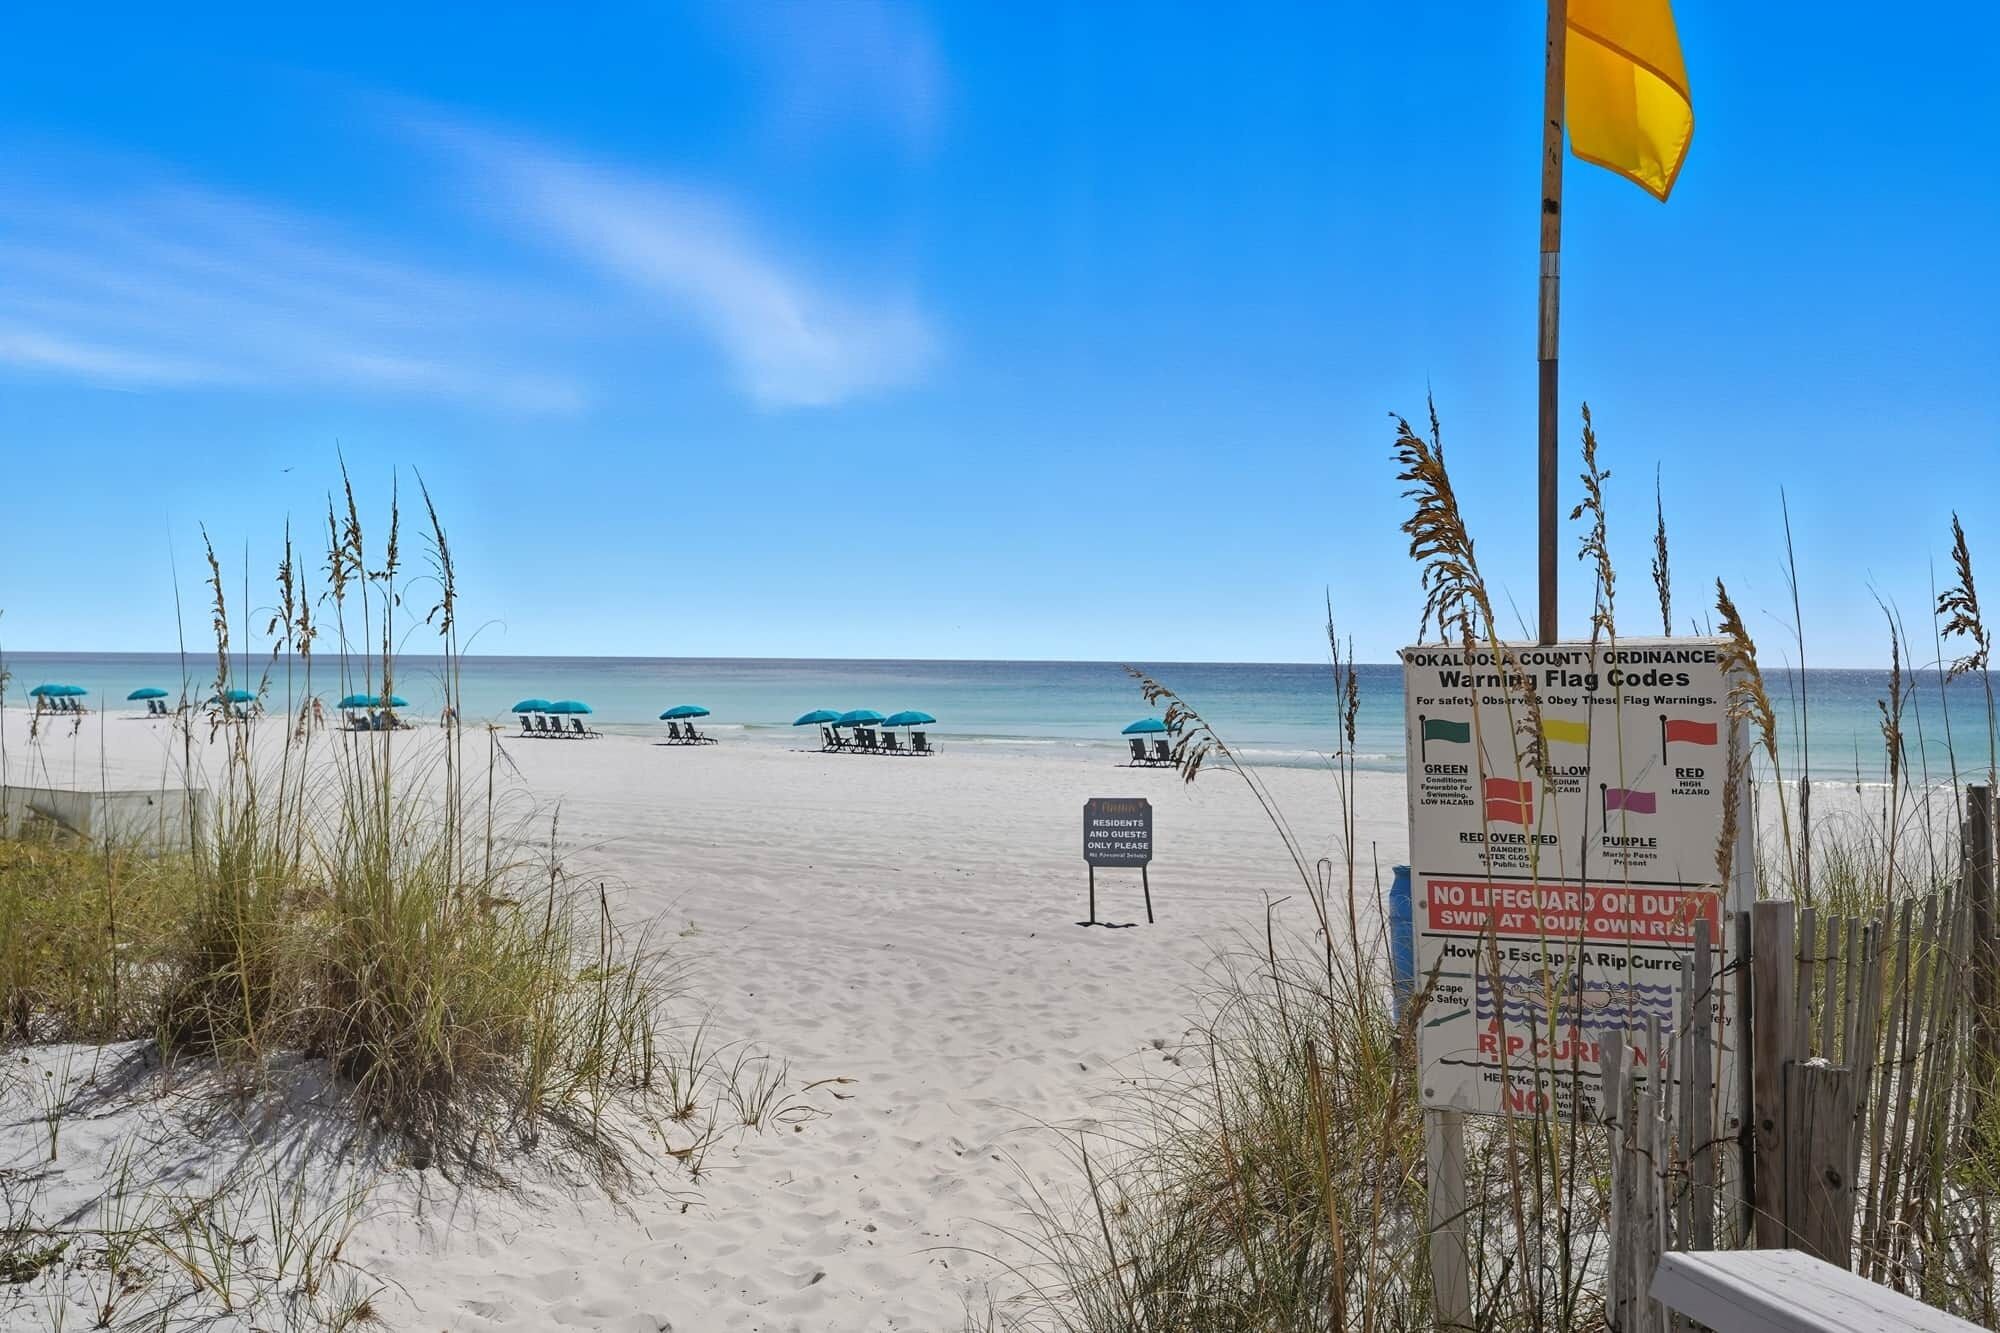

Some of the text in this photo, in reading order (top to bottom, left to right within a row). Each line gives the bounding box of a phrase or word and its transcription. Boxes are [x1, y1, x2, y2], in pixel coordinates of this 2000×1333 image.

[1603, 651, 1716, 665] ORDINANCE
[1545, 669, 1598, 691] Flag
[1607, 669, 1690, 687] Codes
[1417, 697, 1434, 705] For
[1535, 696, 1543, 705] &
[1548, 696, 1577, 707] Obey
[1624, 696, 1650, 707] Flag
[1654, 695, 1717, 707] Warnings.
[1424, 764, 1468, 774] GREEN
[1537, 766, 1591, 776] ELLOW
[1675, 767, 1704, 778] RED
[1093, 819, 1144, 827] RESIDENTS
[1111, 831, 1147, 839] GUESTS
[1460, 832, 1486, 842] RED
[1490, 833, 1526, 843] OVER
[1115, 842, 1149, 850] PLEASE
[1602, 836, 1657, 847] PURPLE
[1434, 886, 1465, 905] NO
[1471, 887, 1595, 912] LIFEGUARD
[1602, 893, 1636, 914] ON
[1500, 913, 1525, 928] AT
[1530, 914, 1589, 932] YOUR
[1593, 918, 1646, 934] OWN
[1597, 953, 1627, 971] Rip
[1431, 984, 1463, 993] scape
[1437, 994, 1469, 1007] Safety
[1479, 1034, 1524, 1056] RP
